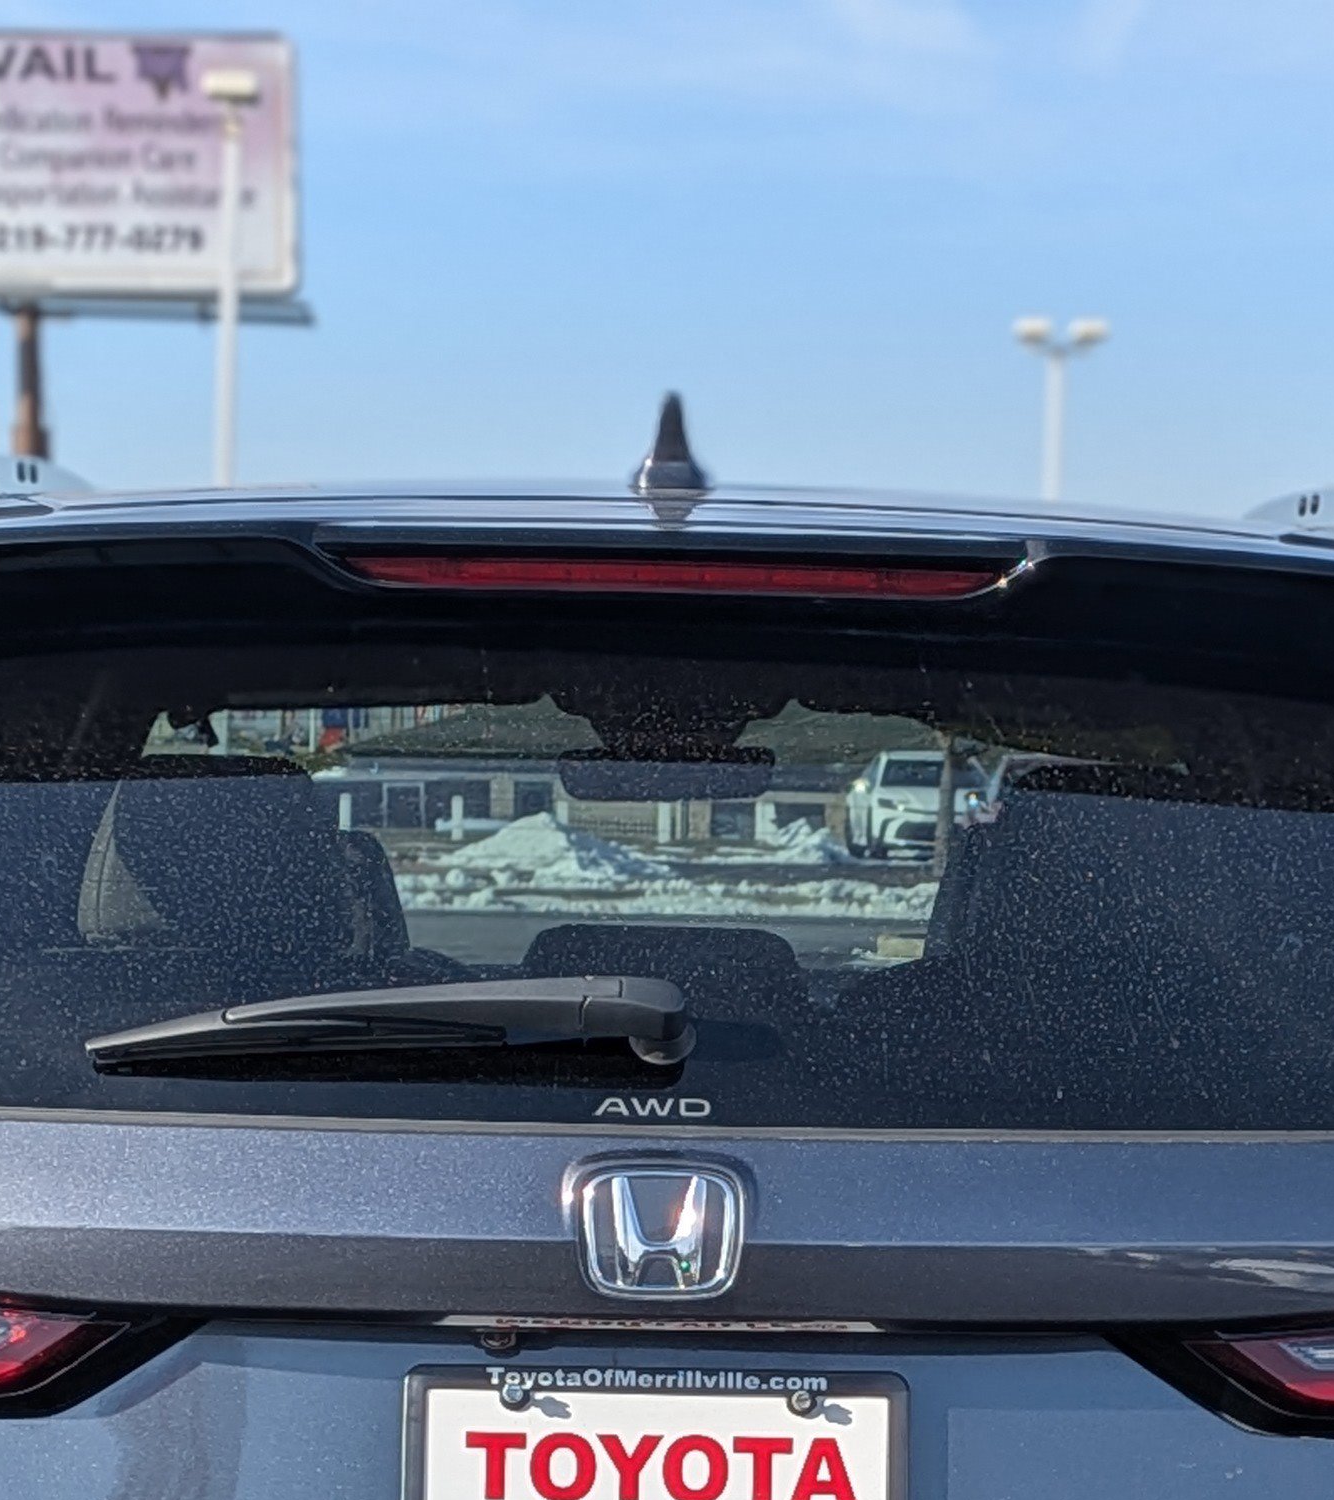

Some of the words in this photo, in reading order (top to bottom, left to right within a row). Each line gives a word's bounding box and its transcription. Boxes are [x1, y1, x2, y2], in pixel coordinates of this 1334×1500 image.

[141, 144, 197, 171] Care
[131, 178, 255, 208] Assistae
[592, 1097, 711, 1117] AWD
[486, 1367, 828, 1391] ToyotaOfMerrillville.com
